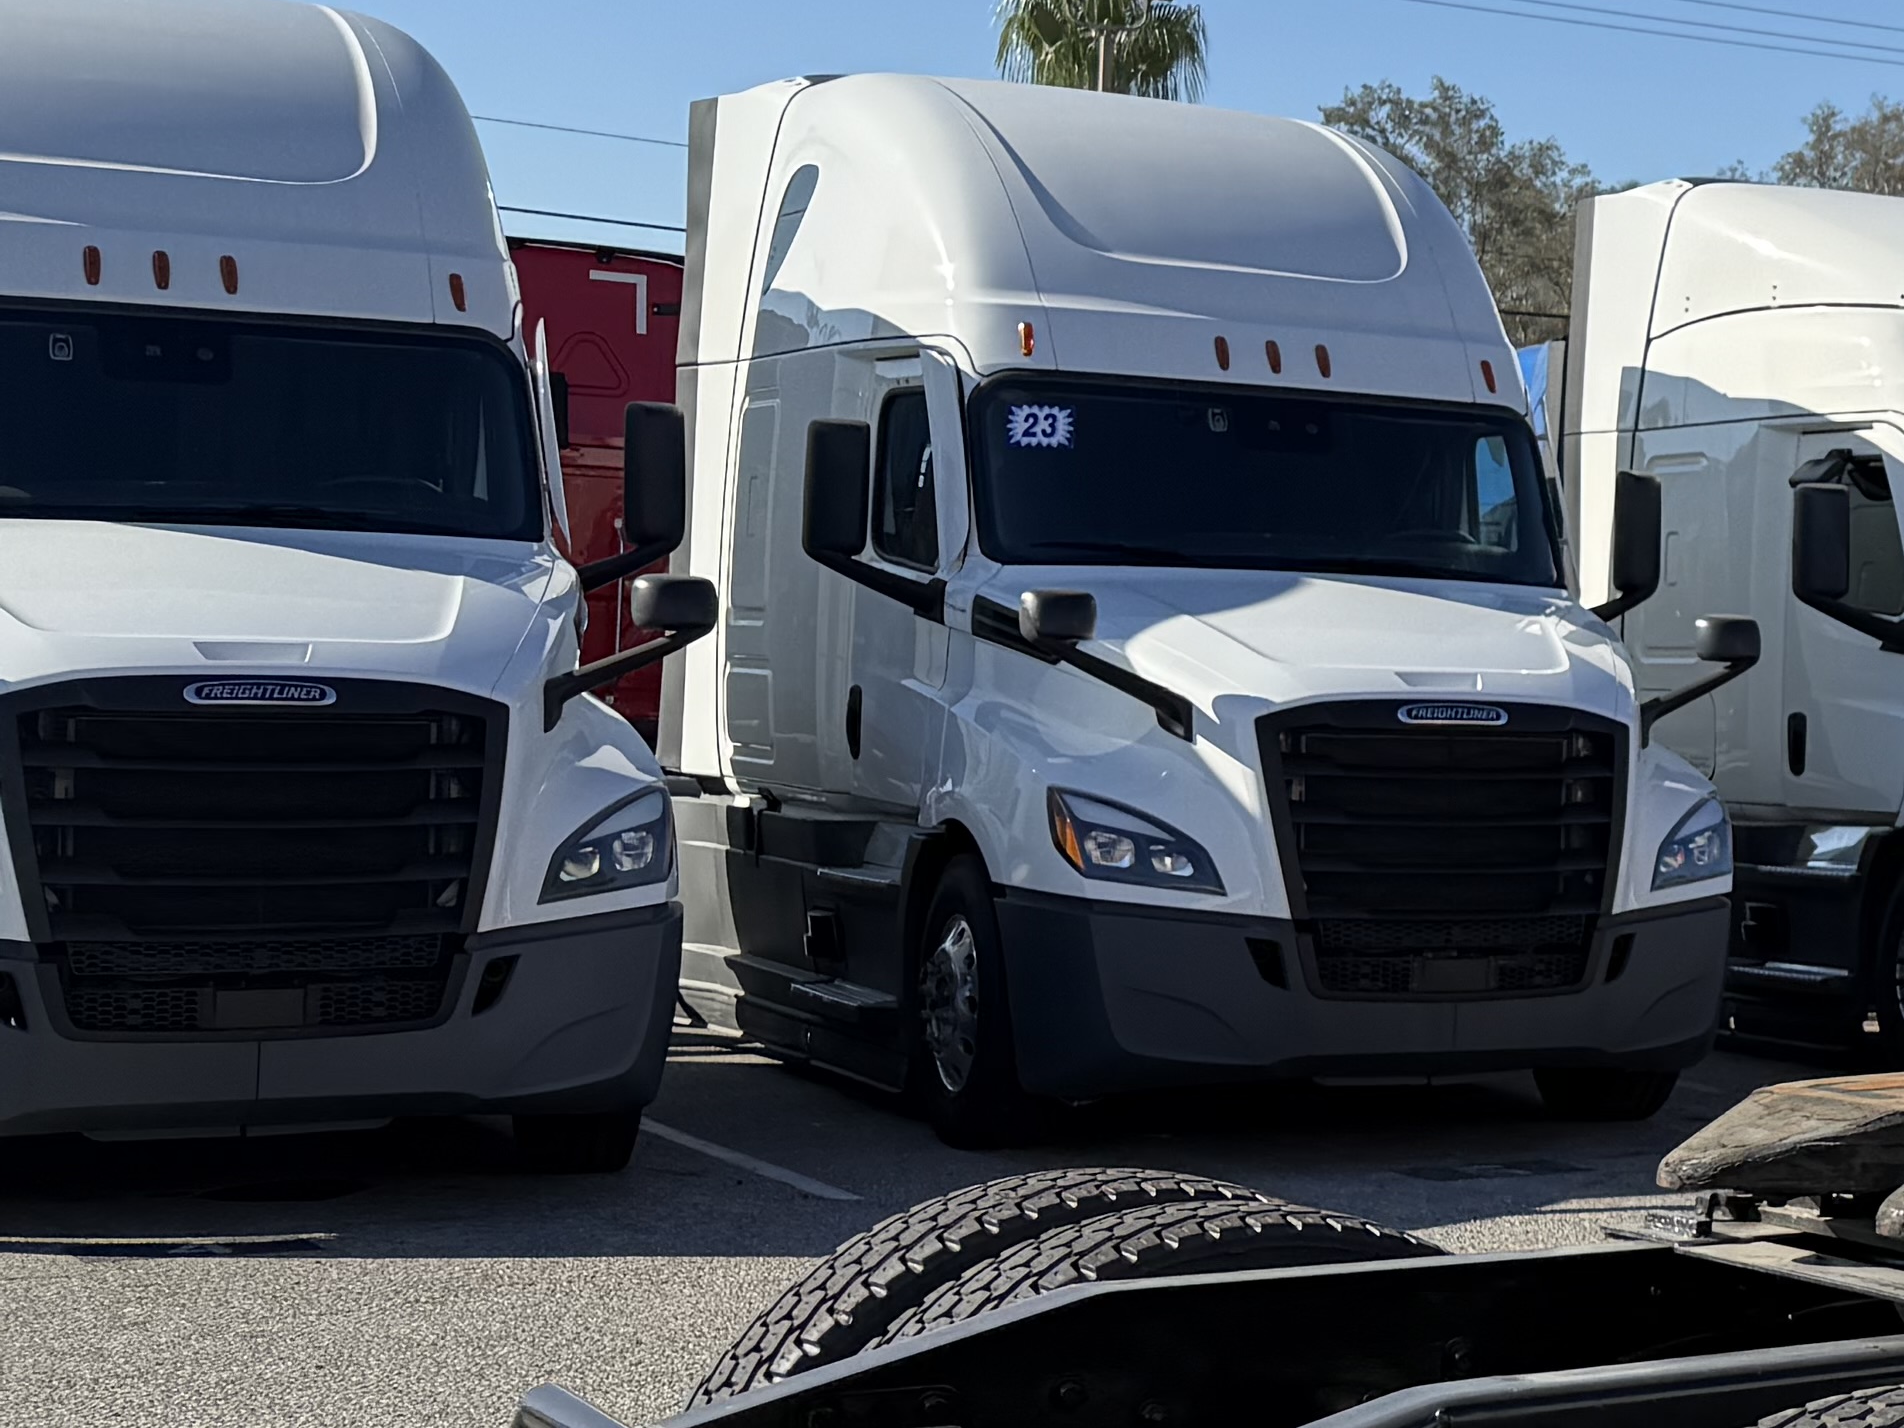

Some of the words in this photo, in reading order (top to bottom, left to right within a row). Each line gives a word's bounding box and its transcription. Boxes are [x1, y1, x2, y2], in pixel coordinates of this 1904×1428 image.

[1022, 413, 1057, 438] 23
[201, 685, 320, 699] FREIGHTLINER
[1411, 707, 1497, 720] FREIGHTLINER
